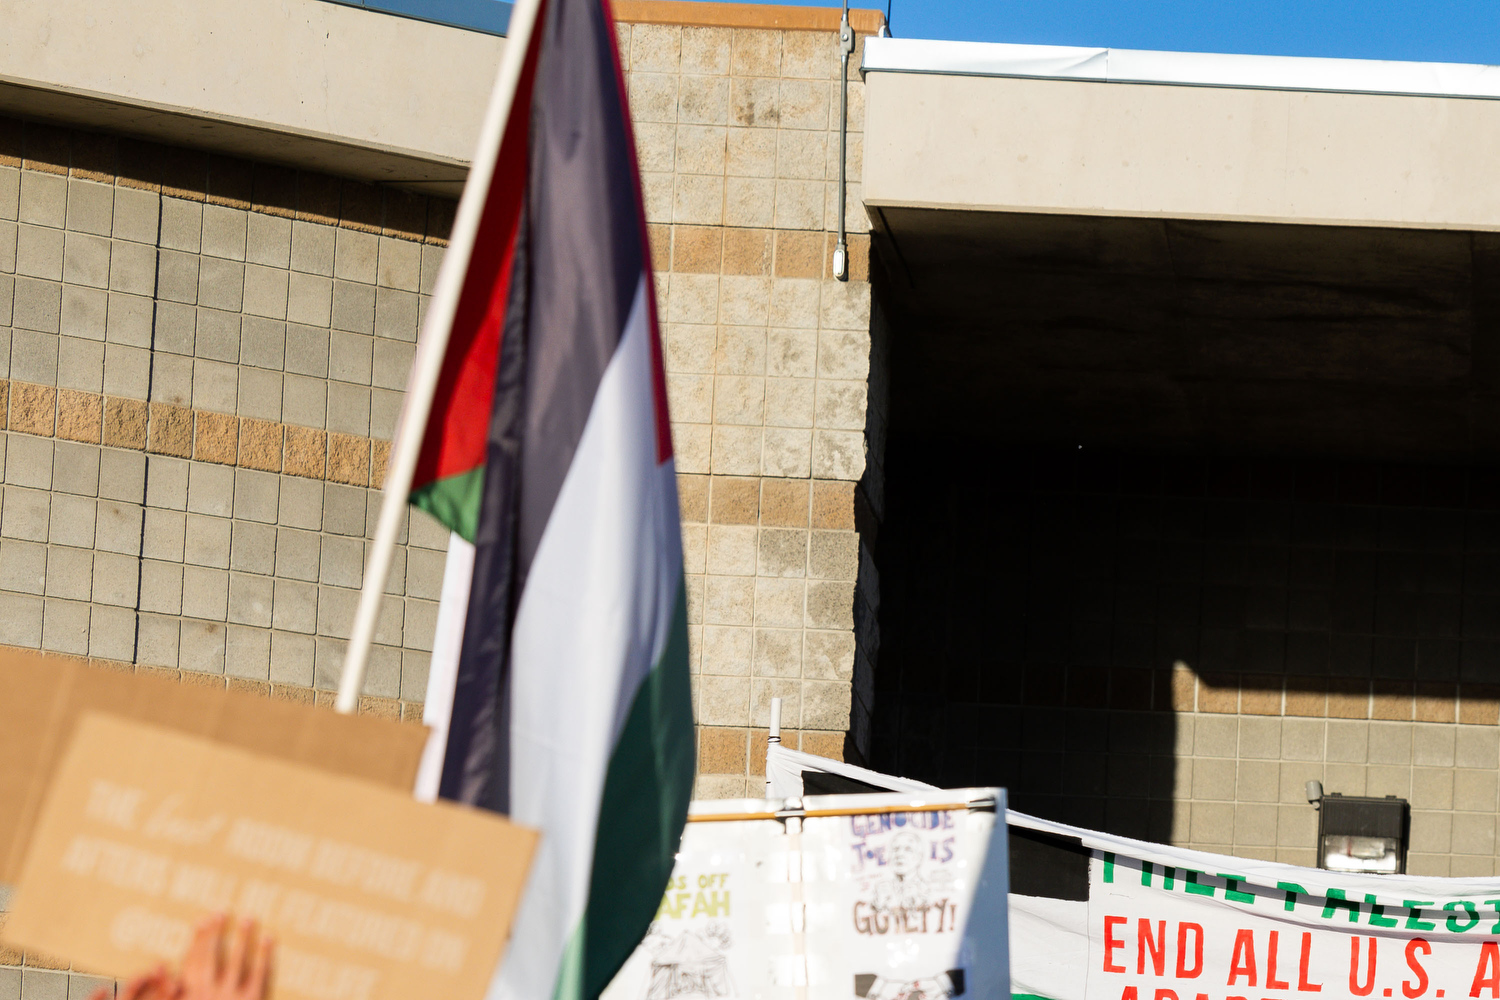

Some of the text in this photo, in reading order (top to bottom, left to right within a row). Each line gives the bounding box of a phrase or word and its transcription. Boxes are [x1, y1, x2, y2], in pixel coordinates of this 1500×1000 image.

[850, 810, 955, 838] GENOCIDE
[930, 837, 955, 863] IS
[698, 873, 729, 889] OFF
[654, 891, 730, 921] AFAH
[853, 898, 958, 935] GUILTY!
[1103, 916, 1204, 980] END
[1227, 929, 1322, 993] ALL
[1349, 936, 1445, 1000] U.S.
